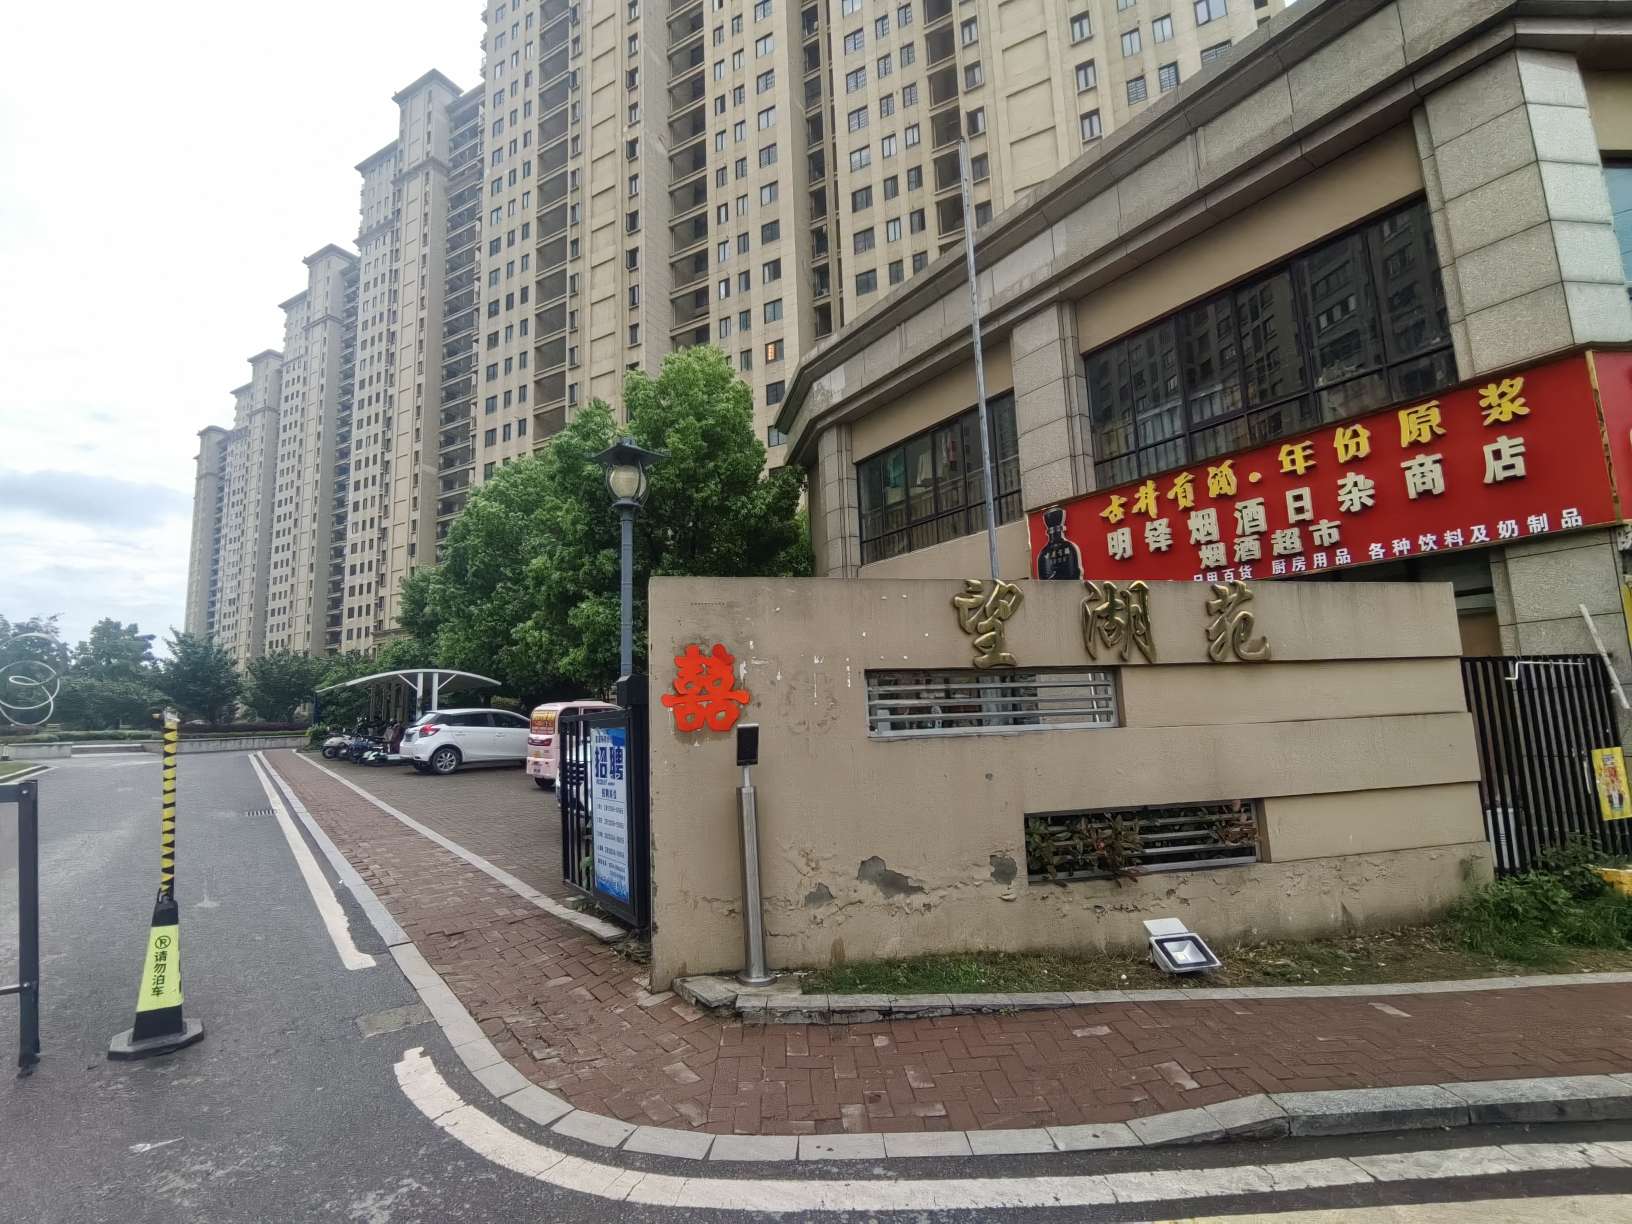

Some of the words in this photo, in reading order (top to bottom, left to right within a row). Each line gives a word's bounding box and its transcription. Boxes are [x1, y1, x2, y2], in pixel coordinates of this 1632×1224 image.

[1199, 518, 1342, 569] 烟酒超市
[1271, 547, 1351, 575] 厨房用品
[1368, 507, 1583, 560] 各种饮料及奶制品
[953, 579, 1271, 668] 望湖苑
[595, 746, 624, 780] 招聘
[152, 950, 168, 997] 请勿泊车
